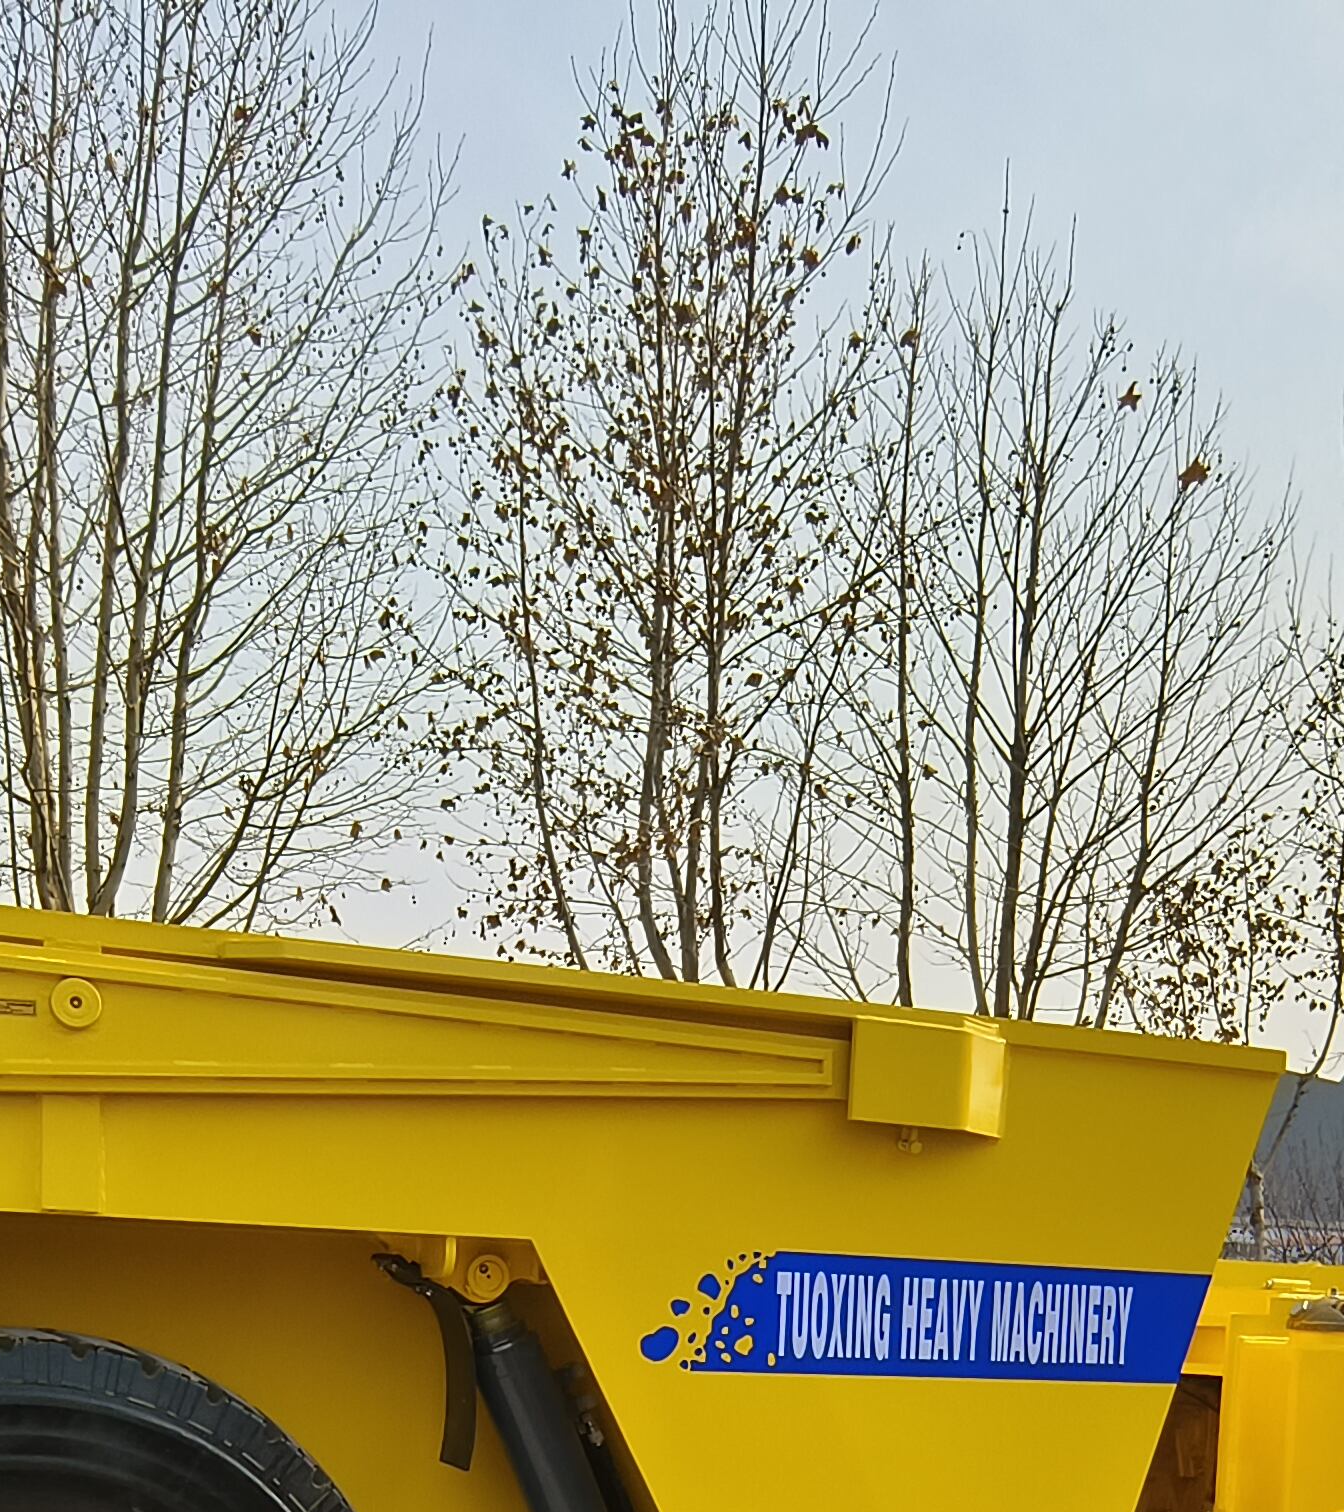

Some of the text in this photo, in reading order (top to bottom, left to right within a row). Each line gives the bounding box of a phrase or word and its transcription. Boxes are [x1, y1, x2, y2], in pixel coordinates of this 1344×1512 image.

[776, 1271, 1134, 1366] TUOXING HEAVY MACHINERY
